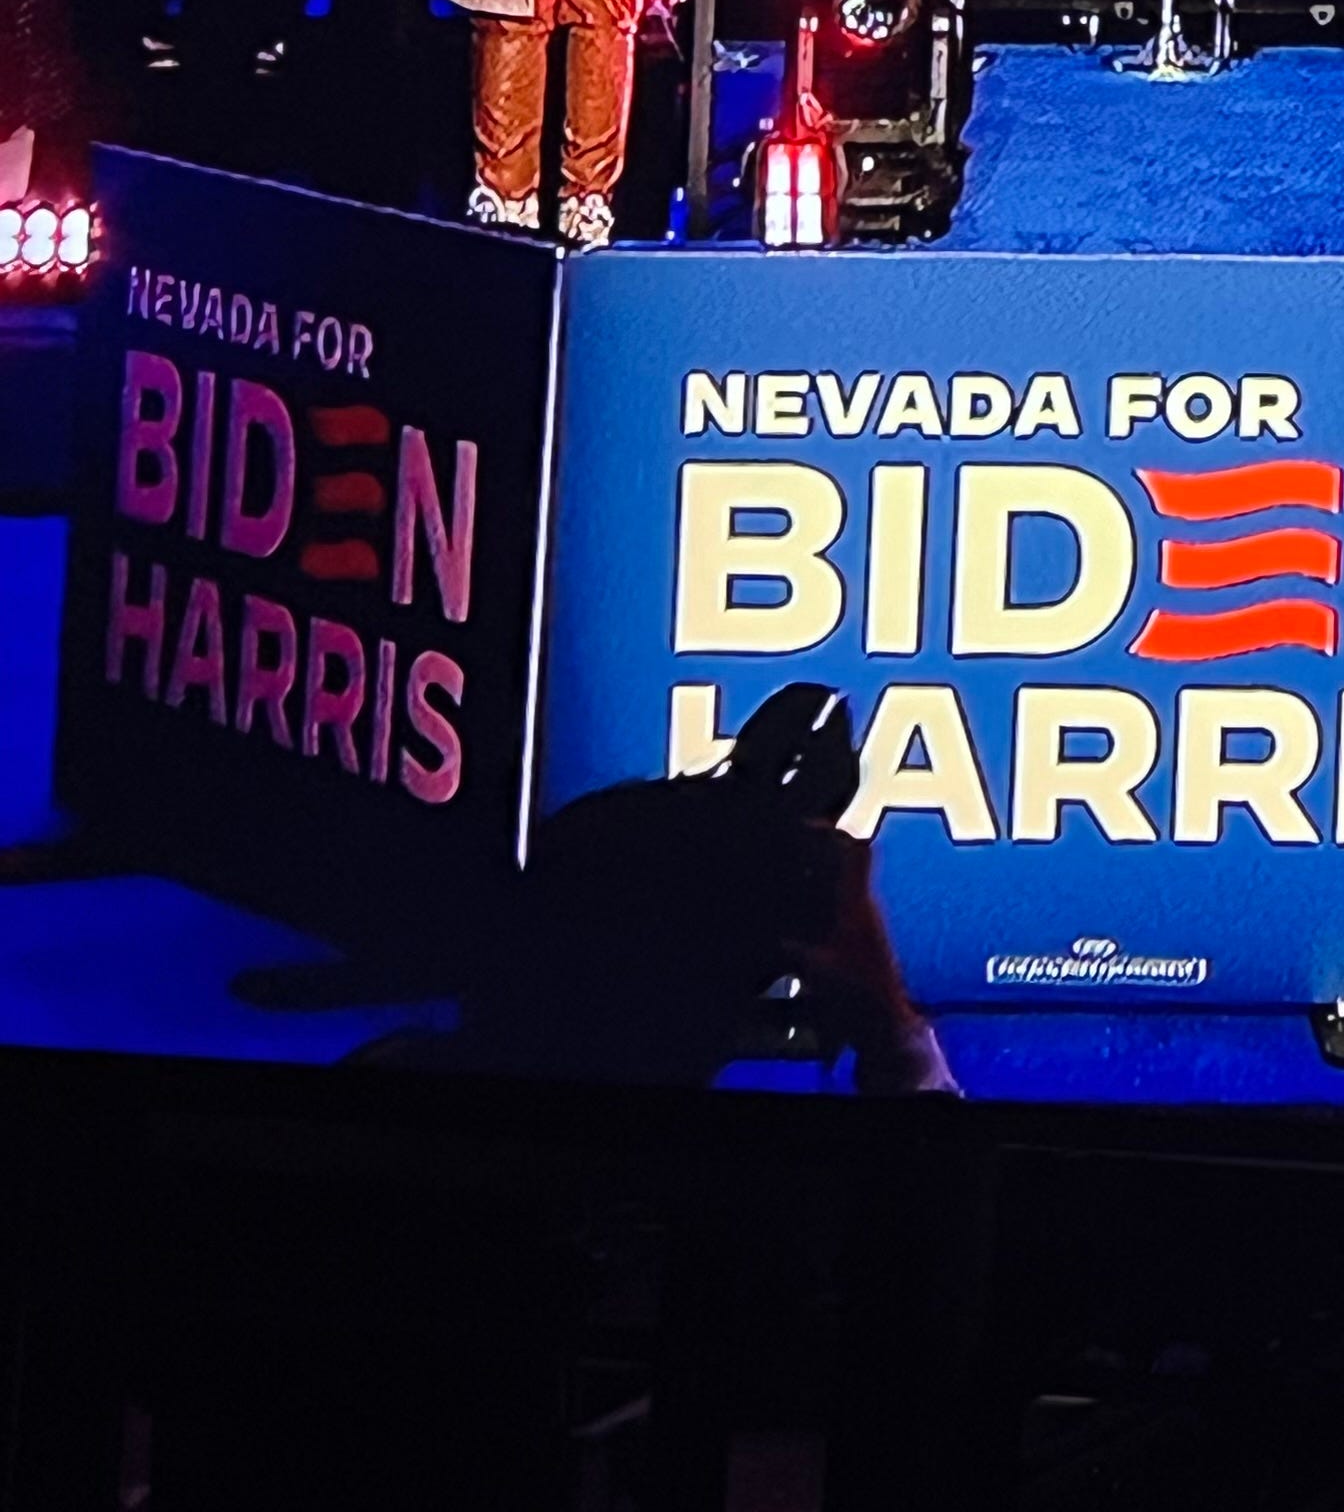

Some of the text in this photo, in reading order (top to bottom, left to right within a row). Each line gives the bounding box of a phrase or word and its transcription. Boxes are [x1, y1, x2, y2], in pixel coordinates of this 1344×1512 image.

[126, 264, 375, 379] NEVADA FOR
[681, 371, 1303, 440] NEVADA FOR
[115, 349, 479, 623] BIDEN
[105, 550, 466, 804] HARRIS
